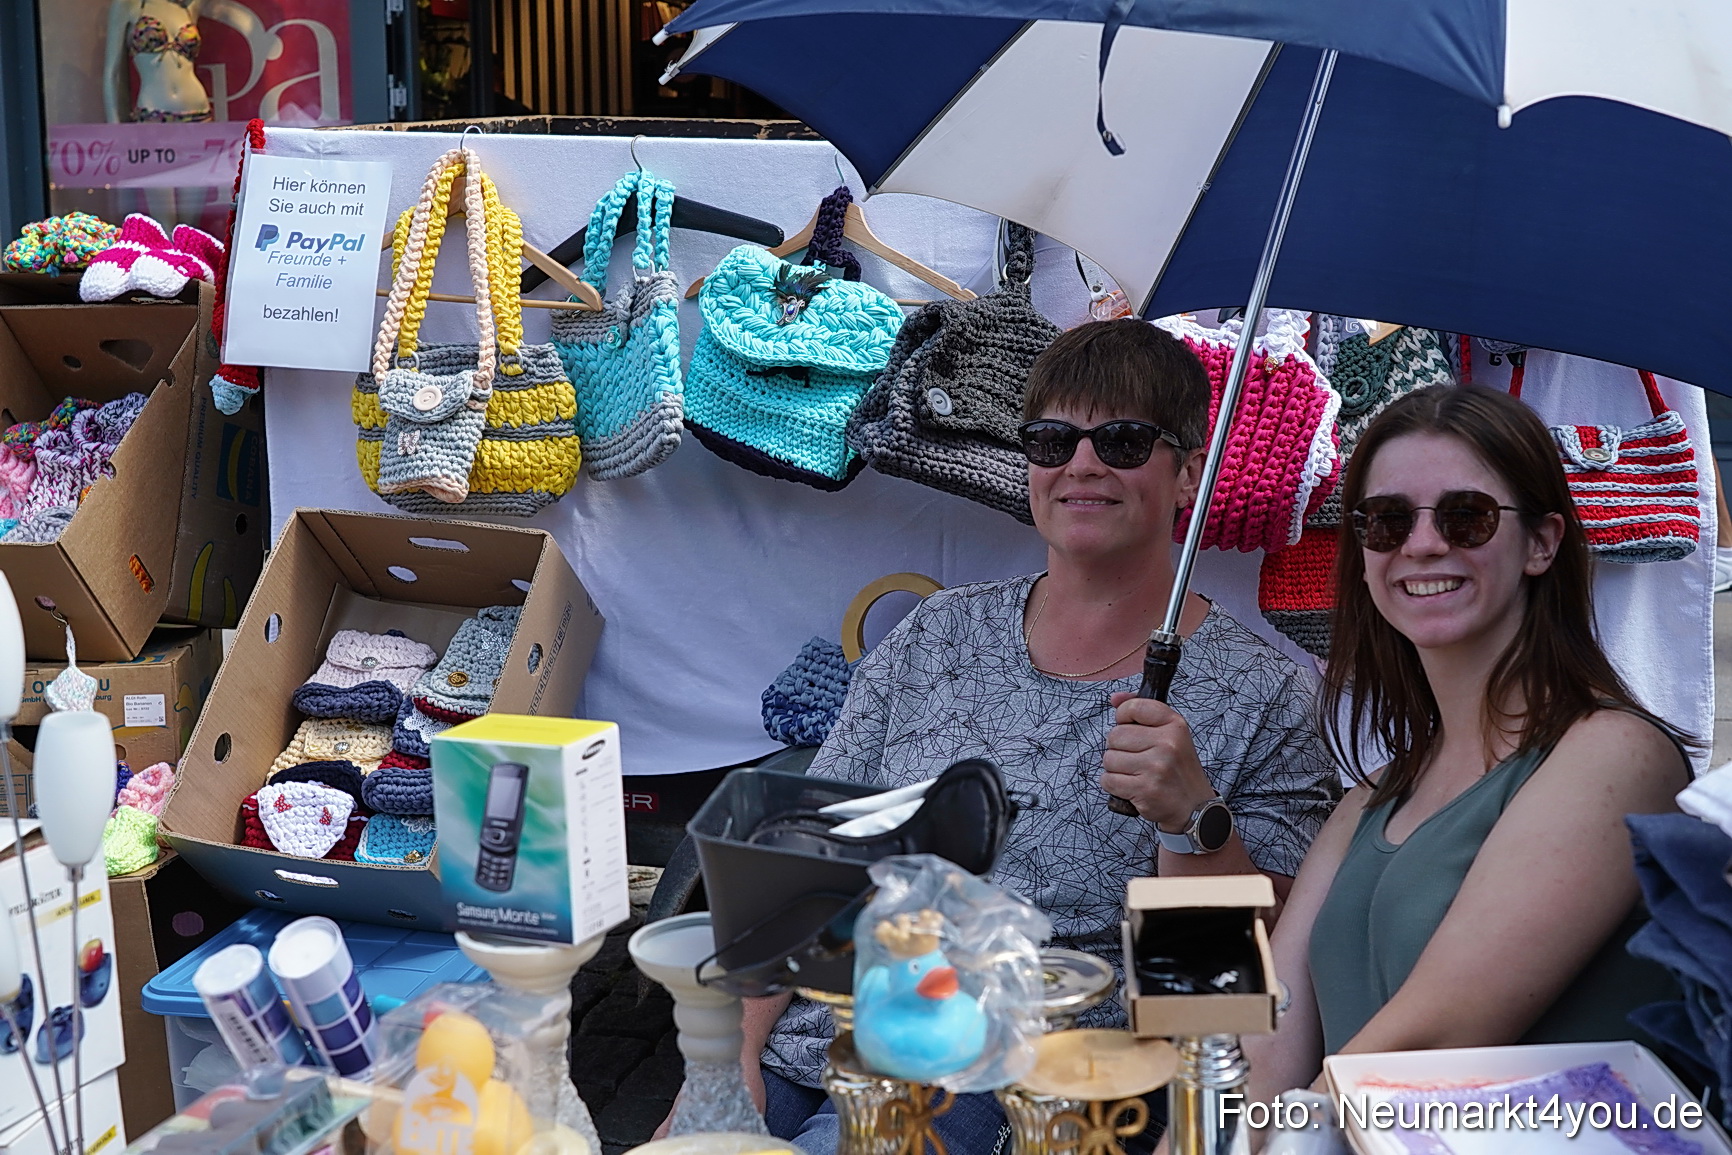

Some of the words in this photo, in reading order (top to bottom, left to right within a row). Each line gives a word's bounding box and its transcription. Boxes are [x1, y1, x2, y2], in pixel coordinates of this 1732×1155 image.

[50, 138, 121, 177] 0%
[127, 148, 150, 164] UP
[157, 148, 176, 164] TO
[272, 176, 306, 191] Hier
[309, 178, 366, 194] können
[268, 198, 294, 213] Sie
[298, 201, 336, 215] auch
[340, 202, 365, 216] mit
[286, 231, 366, 254] PayPal
[267, 250, 332, 267] Freunde
[337, 255, 347, 266] +
[275, 272, 333, 289] Familie
[262, 304, 339, 323] bezahlen!
[196, 397, 208, 449] PREMIUM
[191, 451, 202, 500] QUALITY
[553, 642, 560, 654] 17
[95, 694, 112, 702] burg
[456, 902, 499, 925] Samsung
[499, 907, 541, 926] Monte
